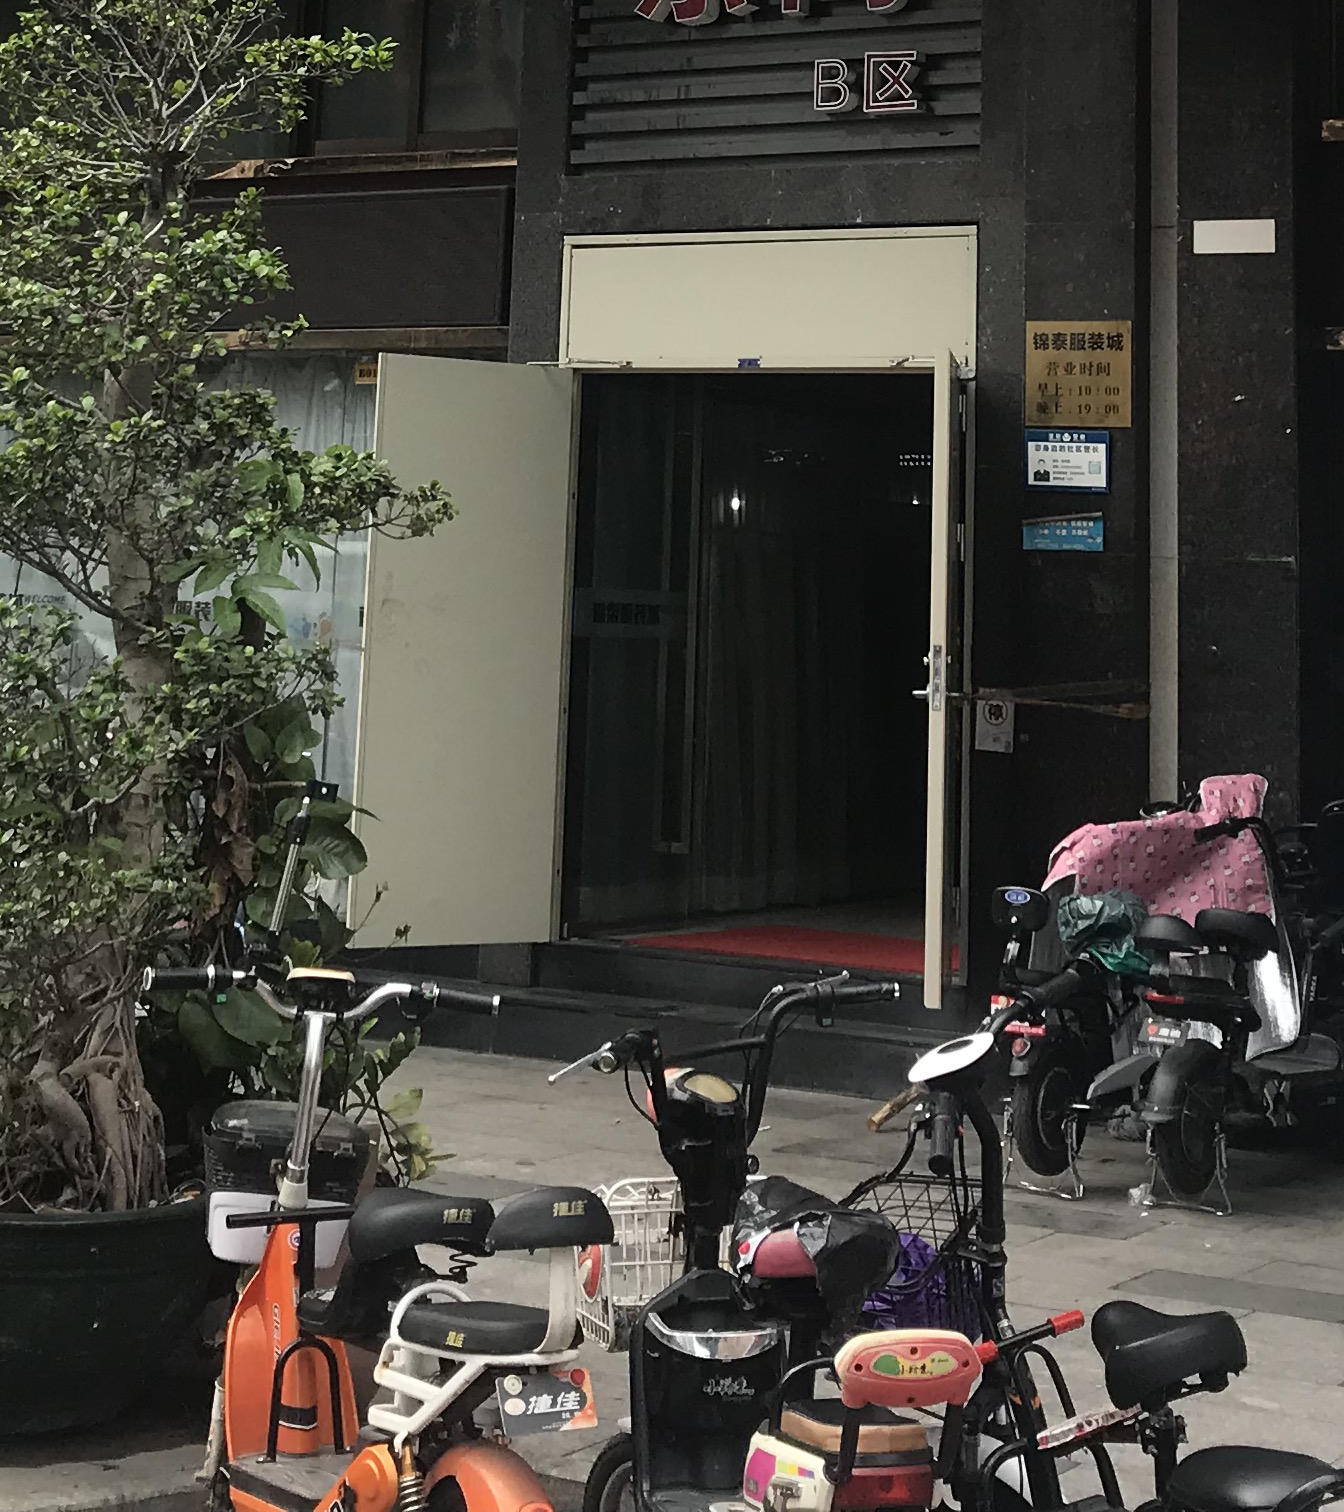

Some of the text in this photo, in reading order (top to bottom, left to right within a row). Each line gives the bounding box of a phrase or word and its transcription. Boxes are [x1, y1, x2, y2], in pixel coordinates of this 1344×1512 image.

[812, 50, 919, 113] B区
[1033, 332, 1125, 351] 锦泰服装城
[1046, 361, 1111, 376] 营业时间
[25, 594, 66, 605] WELCOME
[526, 1390, 581, 1416] 捷佳
